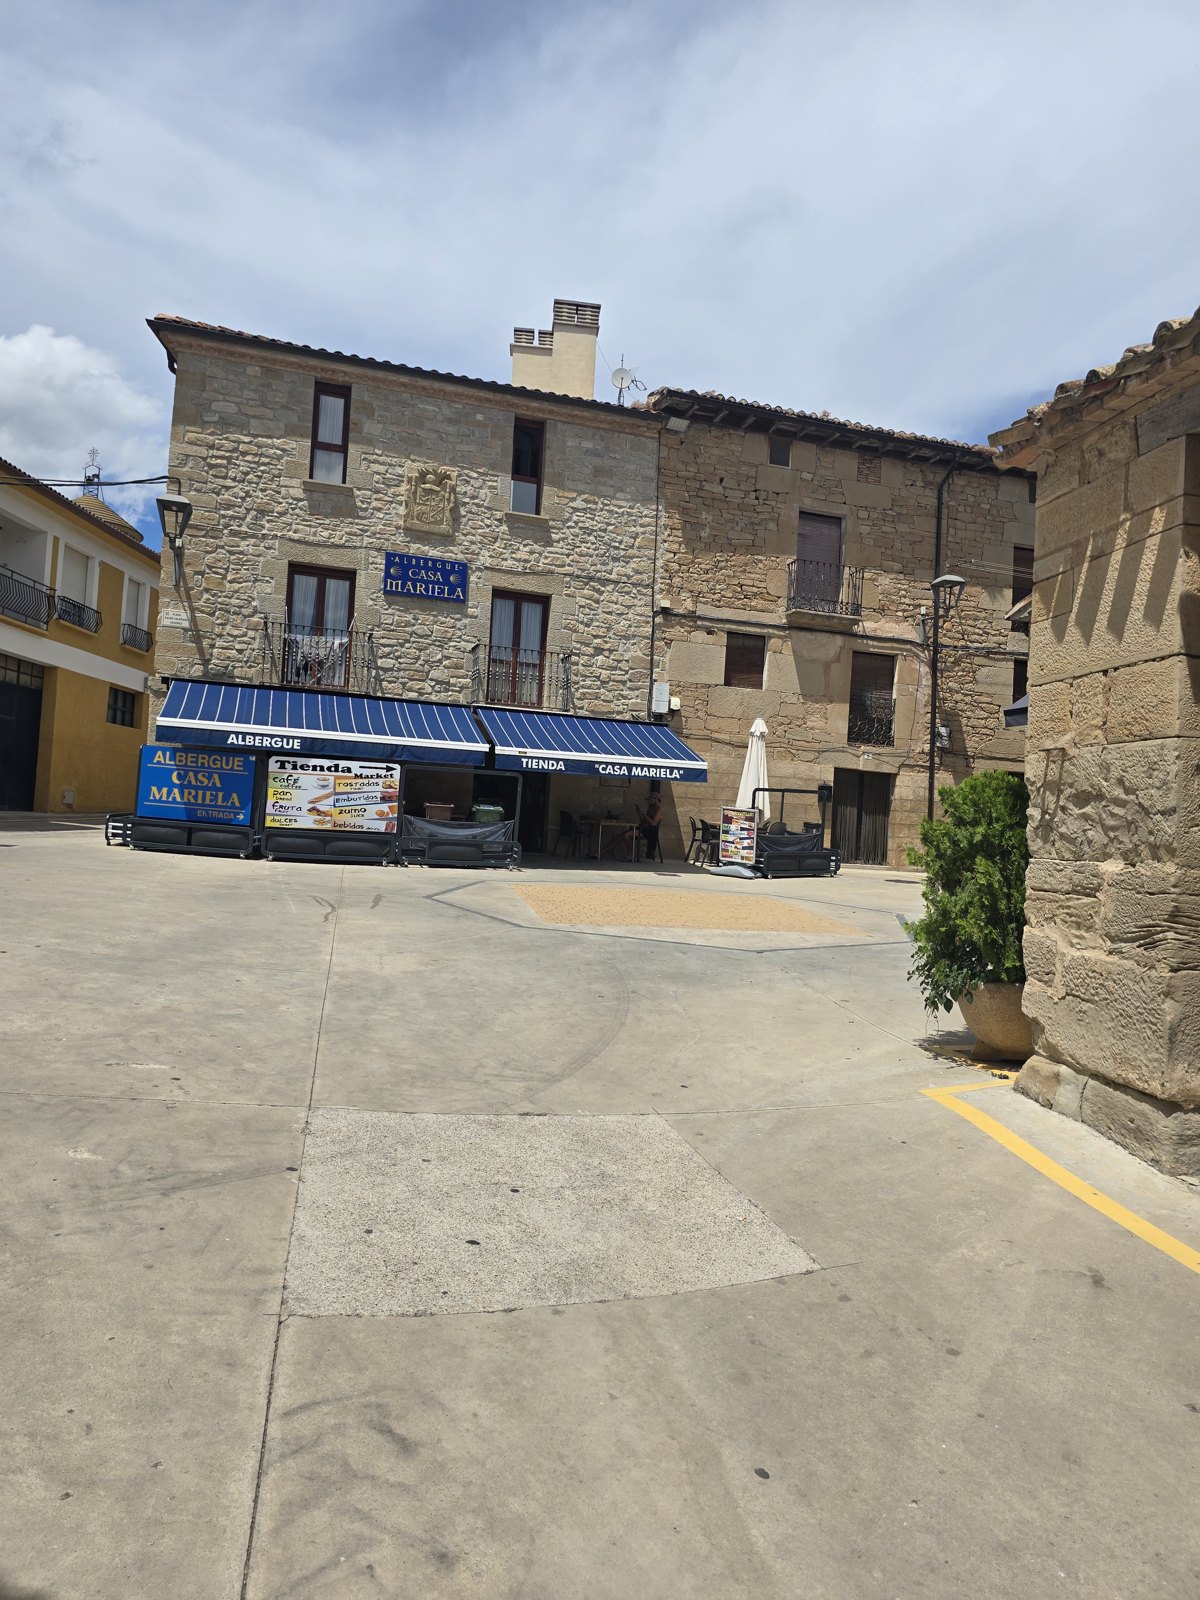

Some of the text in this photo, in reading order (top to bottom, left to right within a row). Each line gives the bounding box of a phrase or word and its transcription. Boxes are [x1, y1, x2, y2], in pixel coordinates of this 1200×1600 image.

[394, 556, 459, 570] ALBERGUE
[408, 568, 443, 582] CASA
[386, 579, 464, 599] MARIELA
[227, 734, 301, 749] ALBERGUE
[153, 751, 245, 770] ALBERGUE
[274, 760, 353, 774] Tienda
[521, 758, 684, 779] TIENDA "CASA MARIELA"
[171, 770, 222, 788] CASA
[149, 786, 241, 807] MARIELA
[272, 789, 292, 799] pan
[333, 821, 364, 829] bebidas
